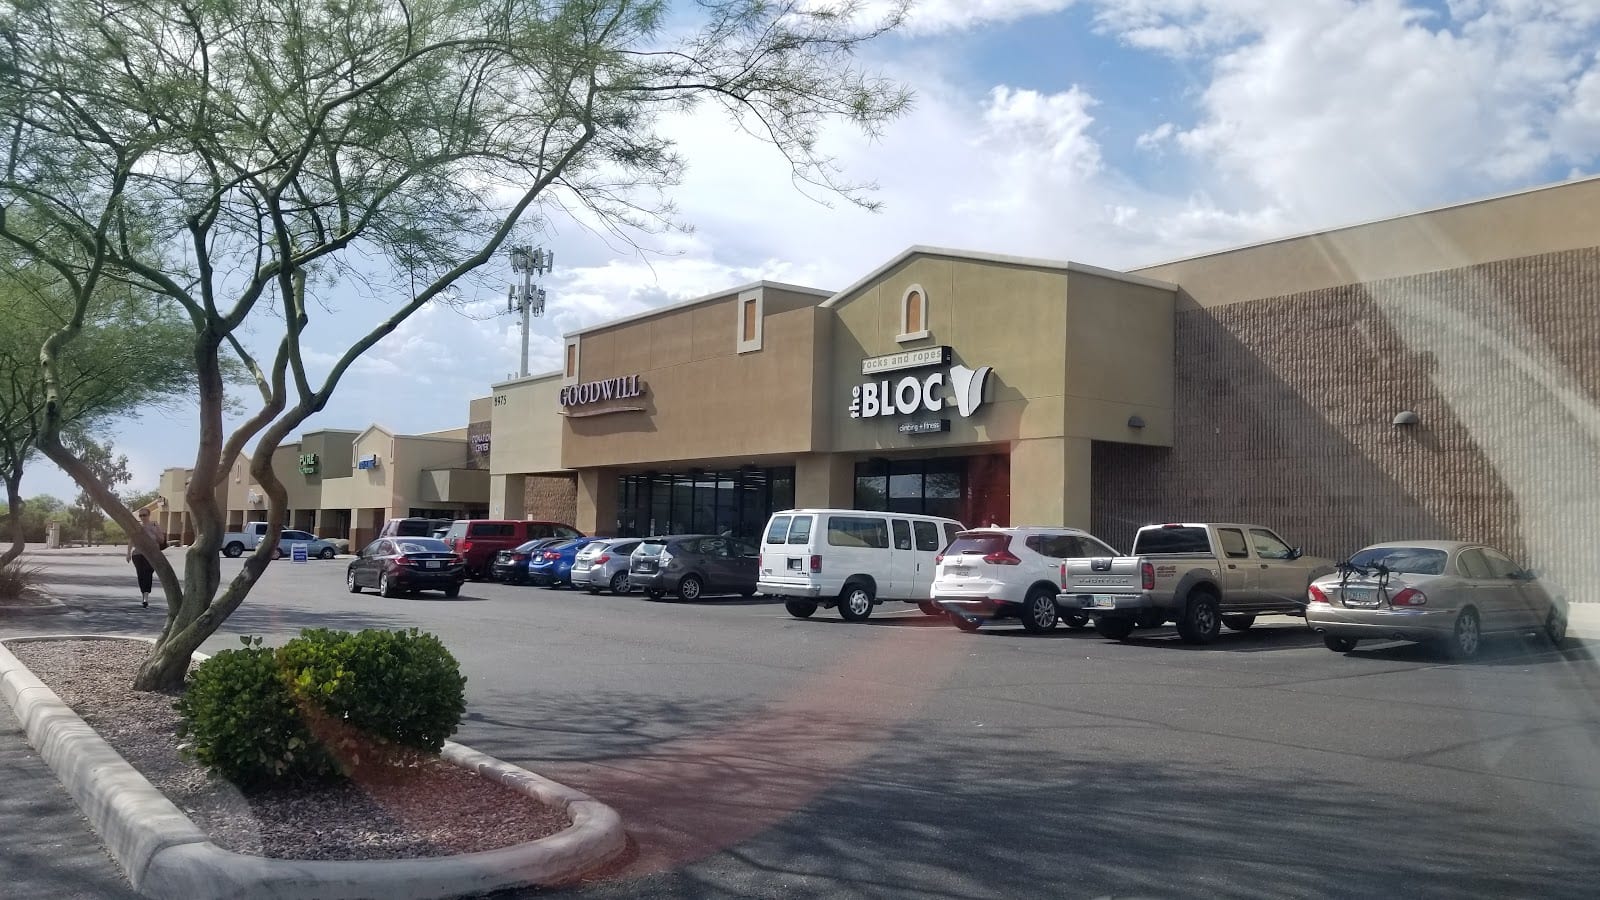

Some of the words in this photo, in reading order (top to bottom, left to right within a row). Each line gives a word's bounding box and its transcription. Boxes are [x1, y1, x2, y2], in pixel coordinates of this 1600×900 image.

[862, 358, 889, 370] rocks
[892, 354, 910, 366] and
[913, 349, 942, 362] ropes
[559, 374, 640, 407] GOODWILL
[849, 385, 861, 419] the
[862, 372, 943, 418] BLOC
[899, 423, 918, 432] climbing
[924, 421, 941, 430] fitness
[299, 452, 315, 465] PURE
